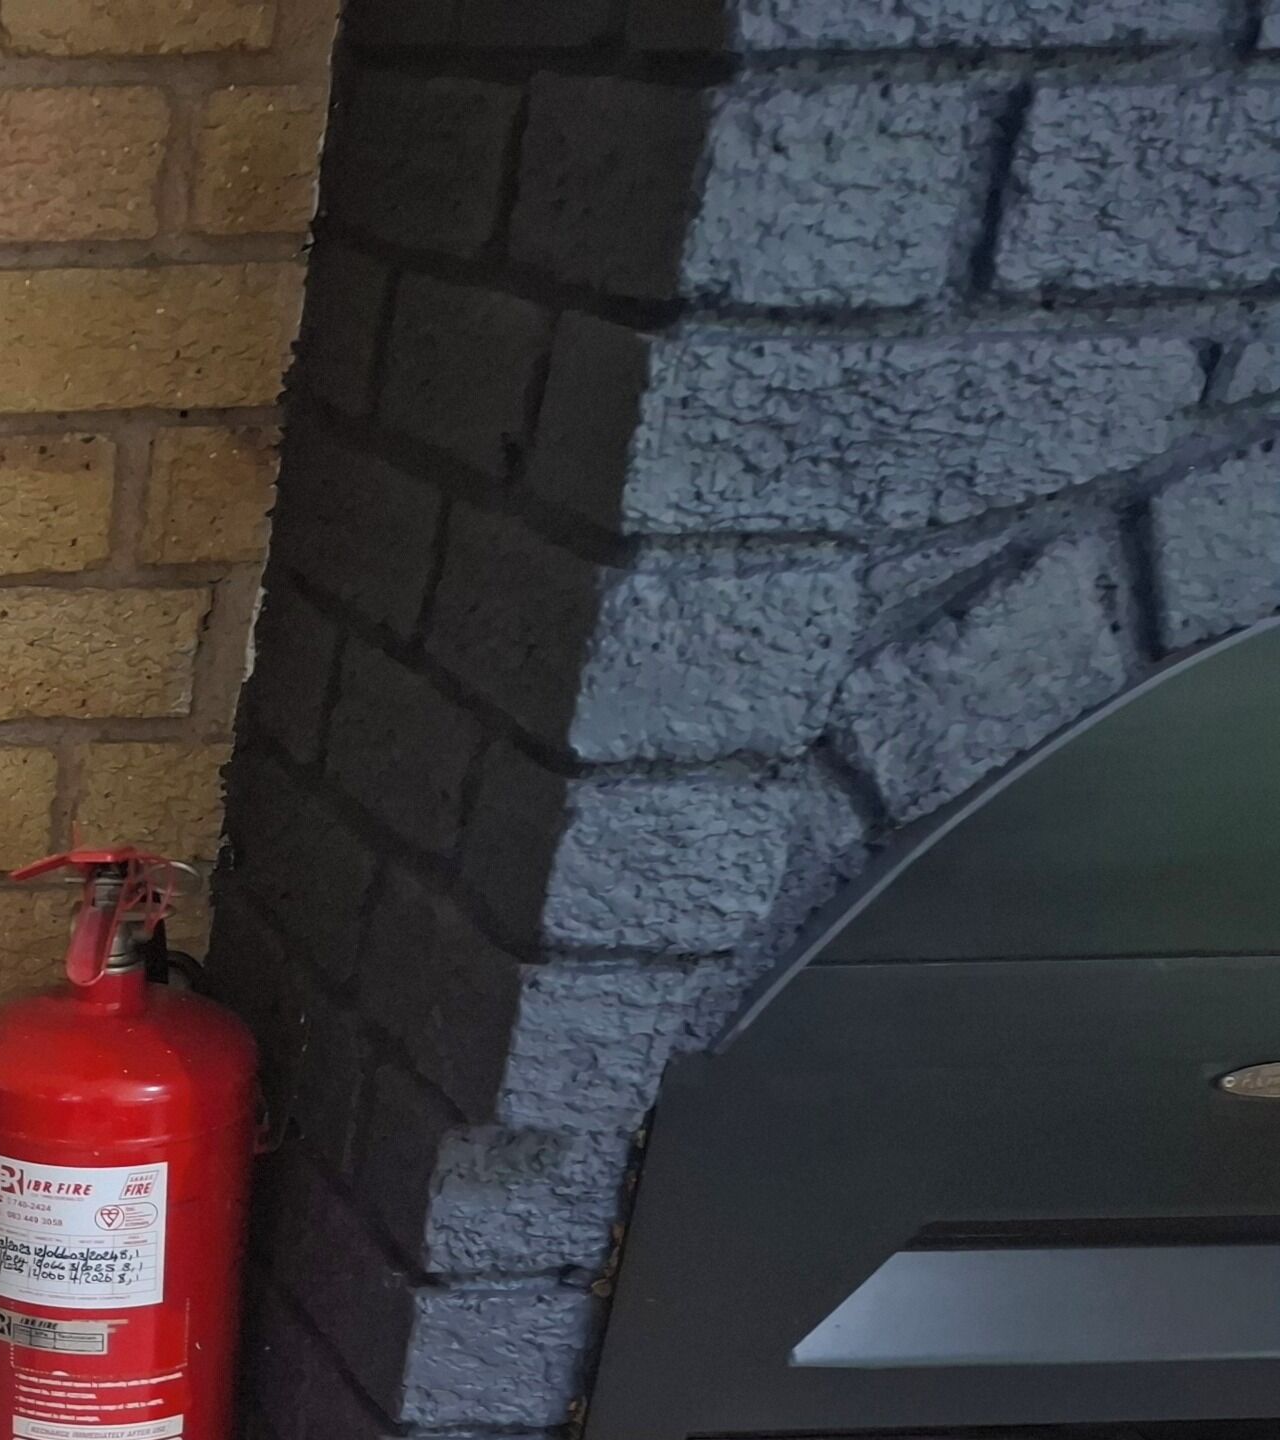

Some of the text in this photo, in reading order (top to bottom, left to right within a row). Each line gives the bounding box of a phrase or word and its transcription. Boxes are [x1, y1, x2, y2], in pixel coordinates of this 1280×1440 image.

[27, 1179, 93, 1196] IBR FIRE
[123, 1182, 152, 1197] FIRE
